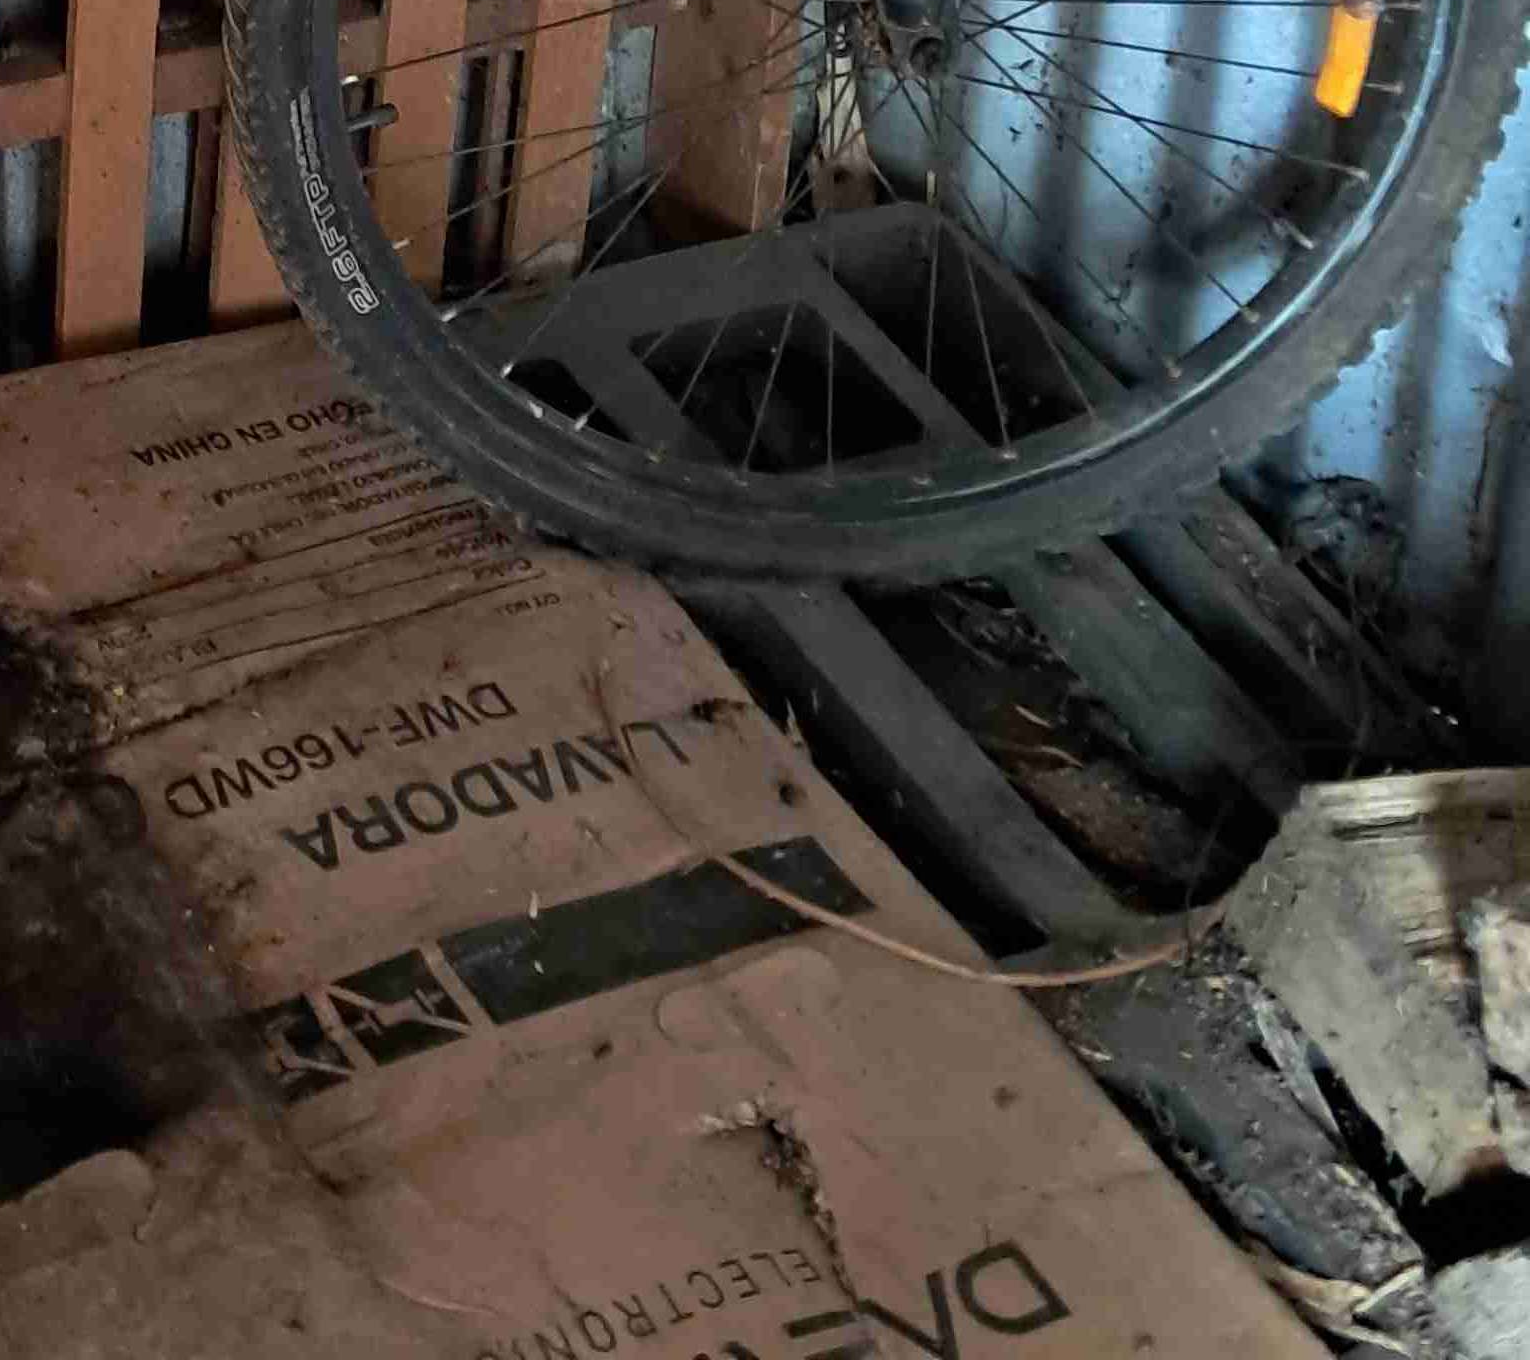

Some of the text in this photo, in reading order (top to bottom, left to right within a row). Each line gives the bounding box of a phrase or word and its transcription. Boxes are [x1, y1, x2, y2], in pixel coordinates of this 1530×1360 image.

[128, 431, 233, 468] CHINA
[234, 420, 285, 447] EN
[164, 682, 518, 820] DWF-166WD
[278, 721, 690, 872] LAVADORA
